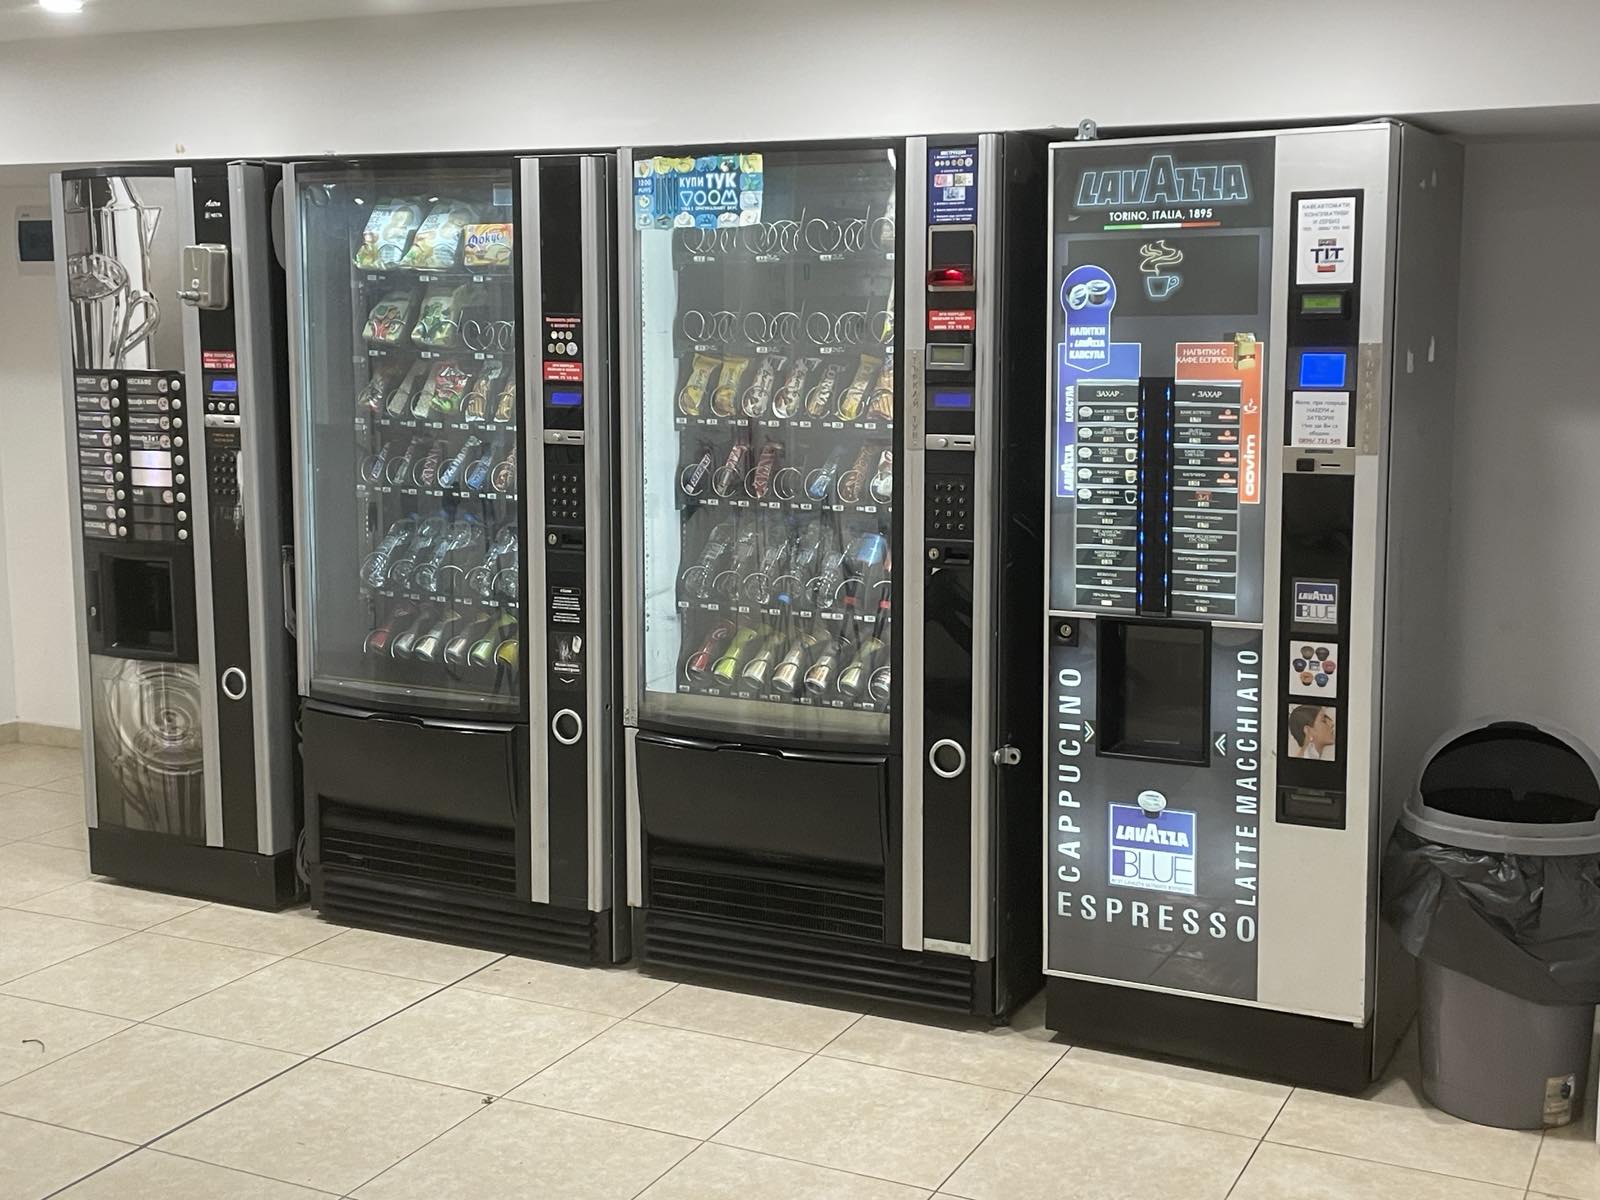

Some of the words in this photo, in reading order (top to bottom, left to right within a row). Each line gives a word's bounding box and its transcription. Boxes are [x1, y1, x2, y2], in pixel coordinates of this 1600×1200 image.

[679, 176, 704, 188] КУПИ
[705, 172, 737, 189] ТУК
[1076, 155, 1249, 206] LAVAZZA
[1109, 210, 1150, 222] TORINO,
[1152, 210, 1186, 221] ITALIA,
[1189, 208, 1213, 219] 1895
[1183, 348, 1221, 356] НАПИТКИ
[1096, 390, 1120, 398] ЗАХАР
[1243, 434, 1256, 497] covim
[1298, 590, 1334, 601] LAVAZZA
[1296, 604, 1337, 620] BLUE
[1236, 650, 1260, 815] MACCHIATO
[1058, 667, 1082, 884] CAPPUCINO
[1115, 823, 1190, 848] LAVAZZA
[1112, 849, 1193, 886] BLUE
[1235, 825, 1257, 906] LATTE
[1057, 891, 1257, 943] ESPRESSO
